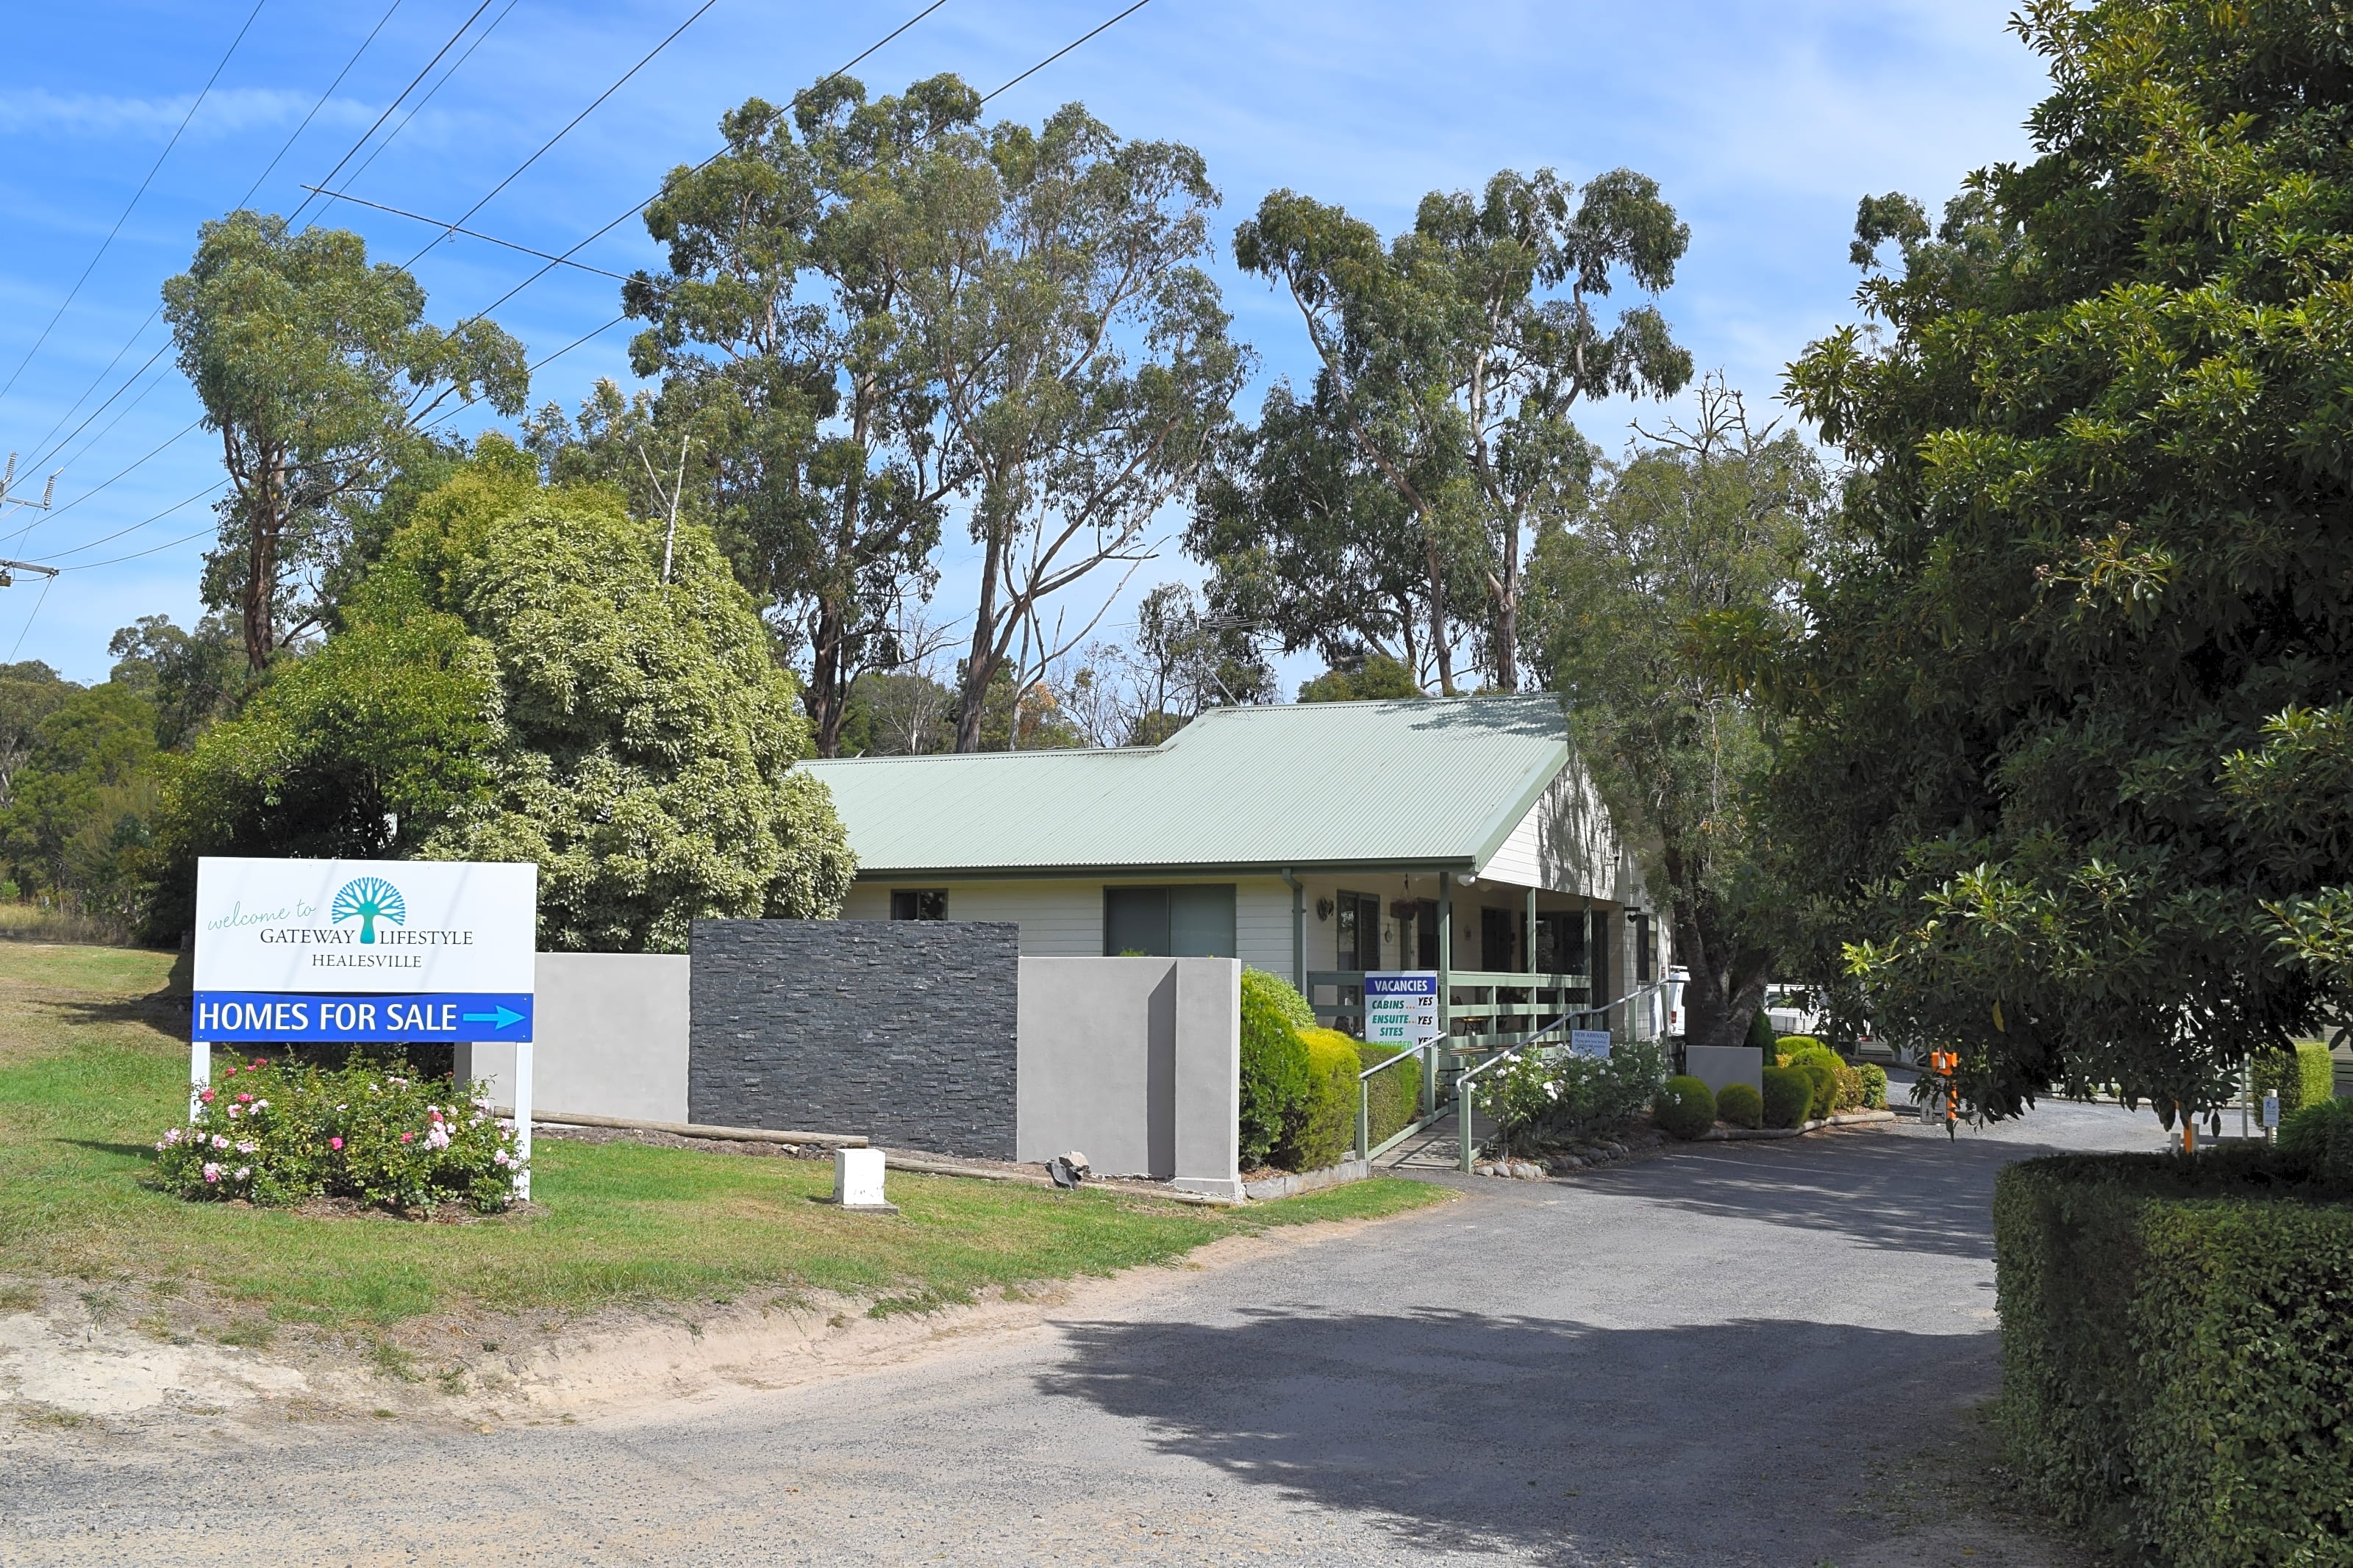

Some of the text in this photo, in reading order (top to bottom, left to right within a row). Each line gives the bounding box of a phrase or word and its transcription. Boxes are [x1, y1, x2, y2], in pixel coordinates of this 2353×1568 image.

[207, 898, 316, 931] welcome to
[260, 928, 474, 945] GATEWAY LIFESTYLE
[312, 953, 422, 968] HEALESVILLE
[1374, 980, 1428, 992] VACANCIES
[1372, 997, 1432, 1009] CABINS YES
[199, 1003, 457, 1031] HOMES FOR SALE
[1418, 1016, 1432, 1025] YES
[1379, 1027, 1404, 1037] SITES
